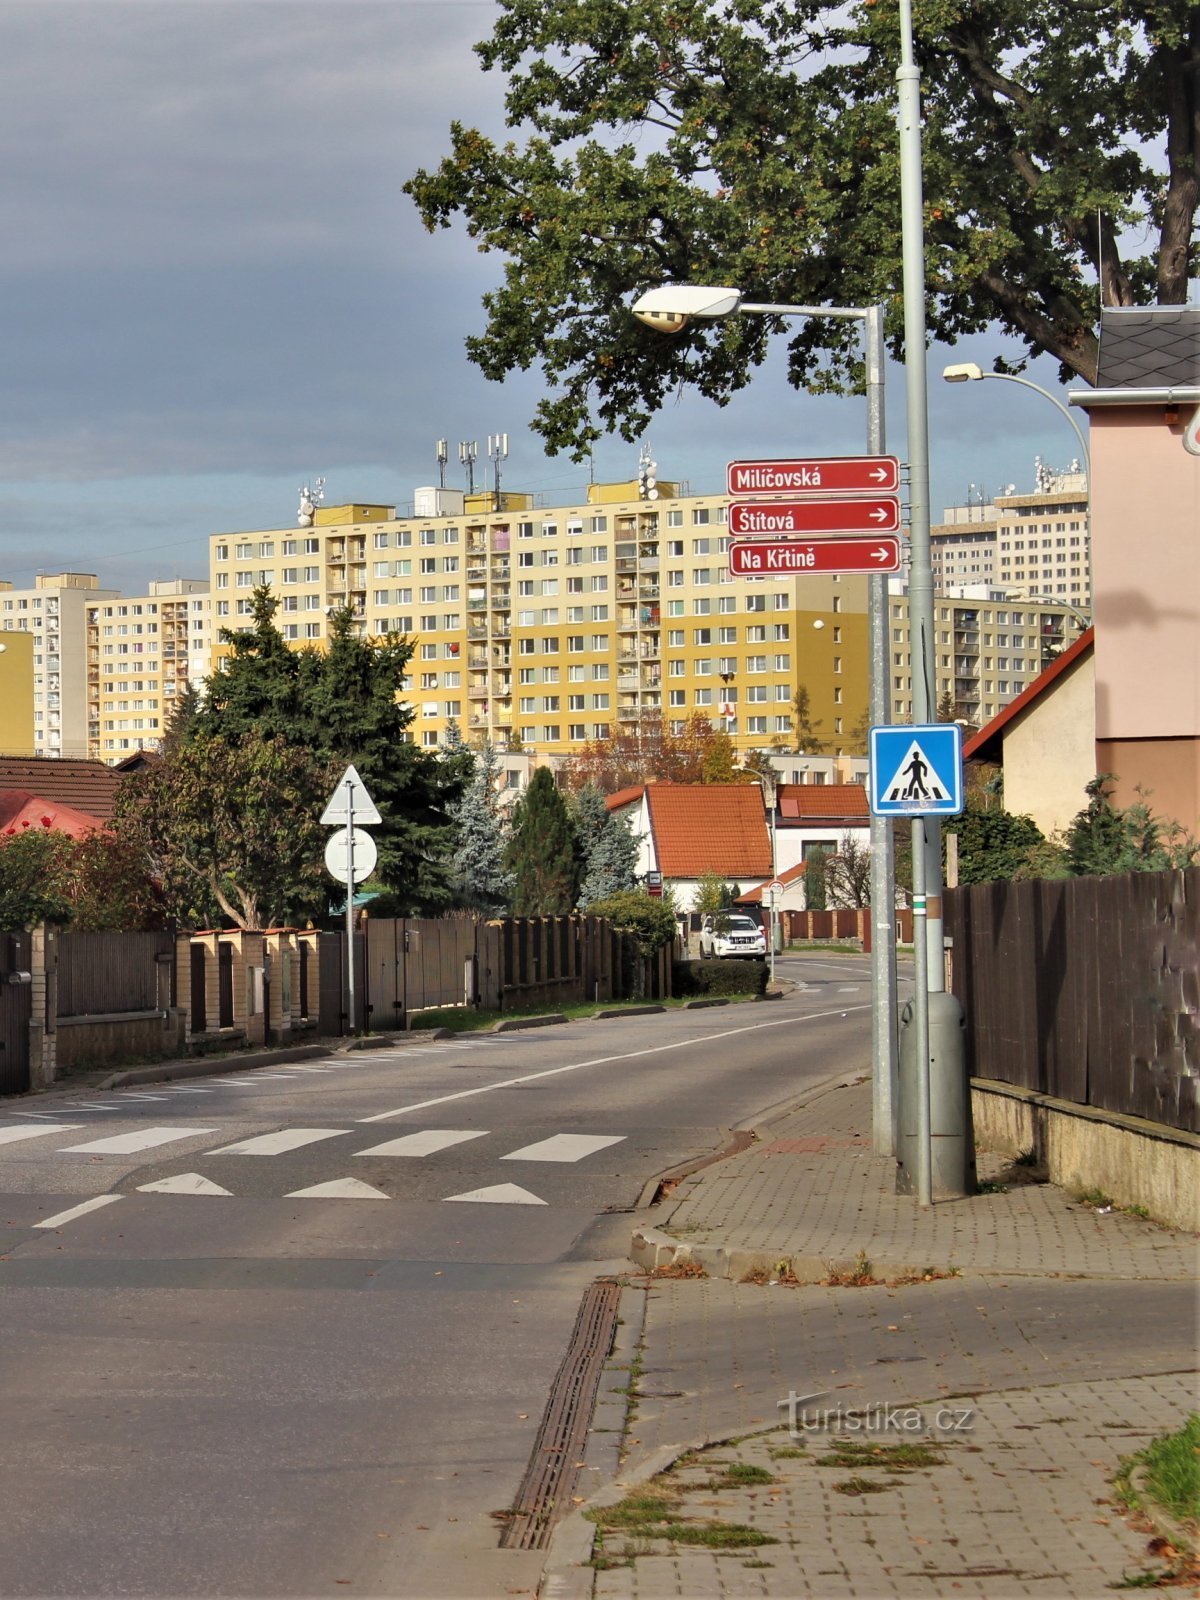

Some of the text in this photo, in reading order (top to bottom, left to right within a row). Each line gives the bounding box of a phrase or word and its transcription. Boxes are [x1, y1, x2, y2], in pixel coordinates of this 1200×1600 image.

[737, 467, 821, 488] Milíčovská
[739, 508, 794, 531] Štítová
[740, 547, 815, 569] Na Křtině
